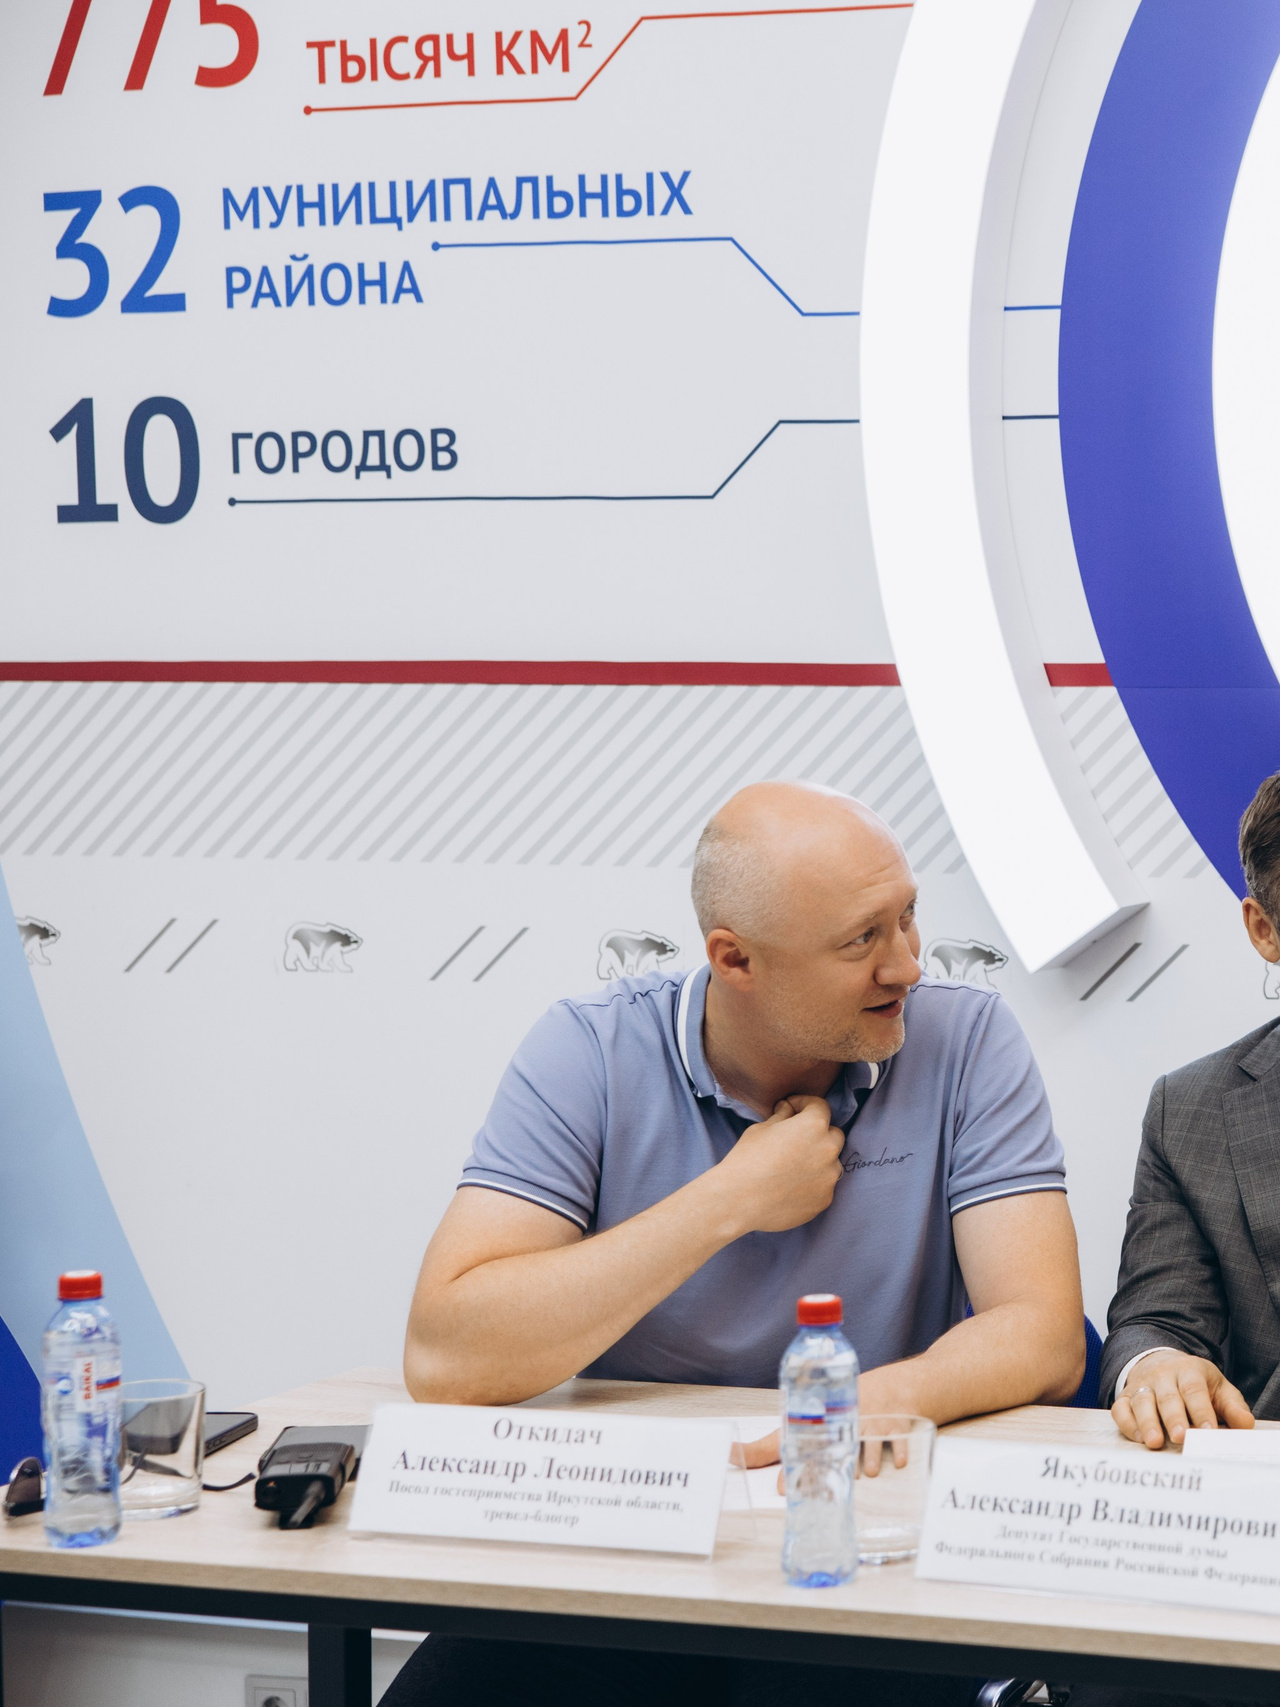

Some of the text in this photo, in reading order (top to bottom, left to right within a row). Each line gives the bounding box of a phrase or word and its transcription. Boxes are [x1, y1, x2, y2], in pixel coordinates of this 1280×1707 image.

[306, 32, 475, 84] ТЫСЯЧ
[223, 171, 693, 231] МУНИЦИПАЛЬНЫХ
[43, 186, 186, 318] 32
[226, 254, 423, 309] РАЙОНА
[49, 396, 458, 524] 10 ГОРОДОВ
[842, 1147, 914, 1173] Giordano
[493, 1417, 603, 1445] Откидач
[392, 1448, 691, 1488] Александр Леонидович
[1040, 1455, 1203, 1492] Якубовский
[388, 1480, 684, 1513] Посол гостеприимства Иркутской области,
[941, 1487, 1082, 1525] Александр
[483, 1509, 580, 1527] тревел-блогер
[935, 1540, 1035, 1562] Федерального
[1039, 1549, 1110, 1570] Собрания
[1115, 1557, 1200, 1579] Российской
[995, 1525, 1229, 1561] Депутат Государственной думы
